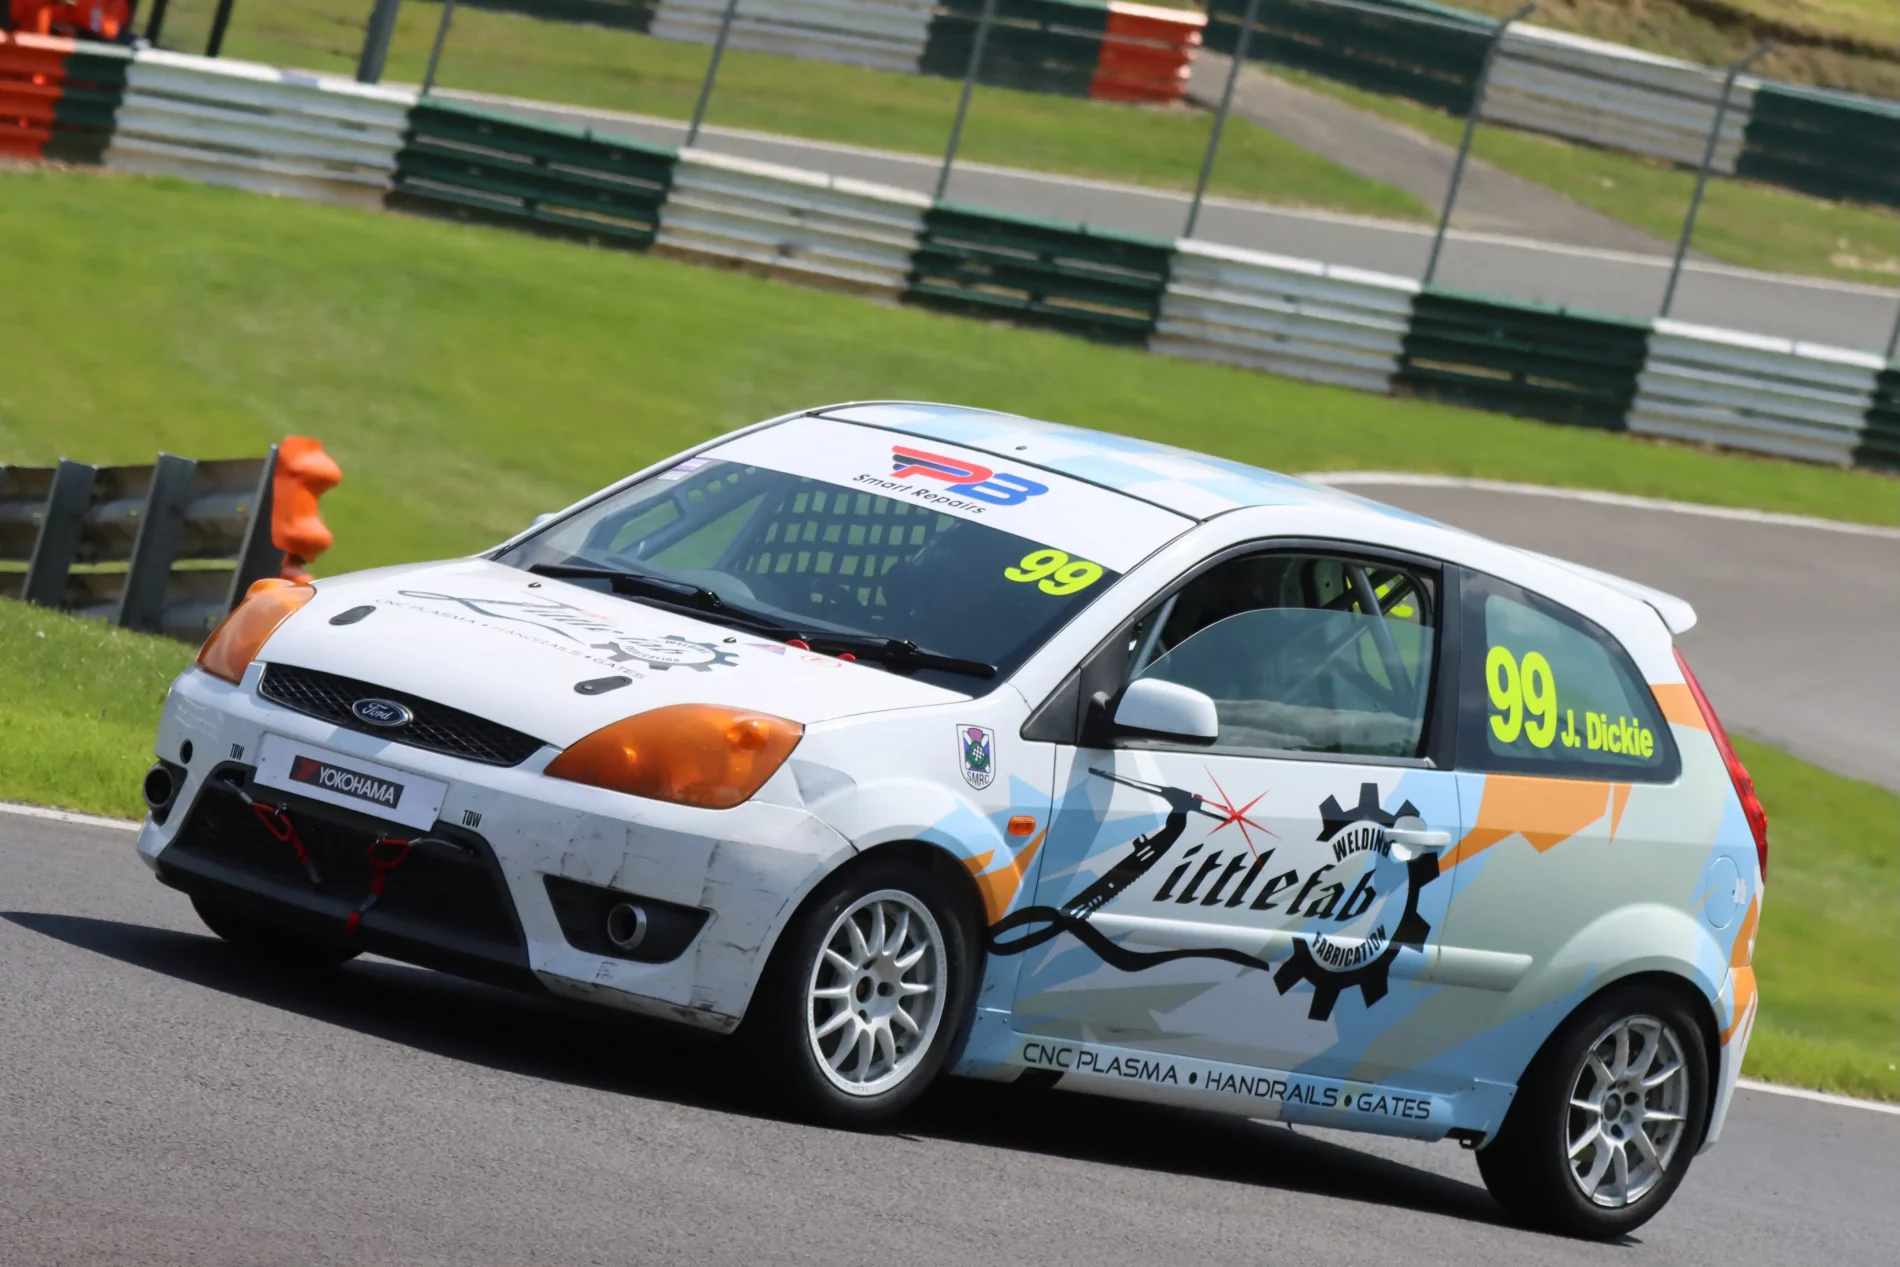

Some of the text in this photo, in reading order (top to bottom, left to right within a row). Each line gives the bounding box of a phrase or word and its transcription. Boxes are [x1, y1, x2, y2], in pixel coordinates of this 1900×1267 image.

[852, 473, 987, 515] Smart Repairs
[1004, 549, 1103, 596] 99
[593, 658, 648, 680] GATES
[361, 702, 392, 721] Ford
[1485, 645, 1558, 748] 99
[229, 743, 245, 761] TOW
[1561, 709, 1654, 758] J. Dickie
[318, 766, 395, 804] YOKOHAMA
[966, 771, 990, 787] SMRC
[461, 809, 483, 828] TOW
[1314, 925, 1386, 967] FABRICATION
[1022, 1042, 1432, 1120] CNC PLASMA HANDRAILS GATES
